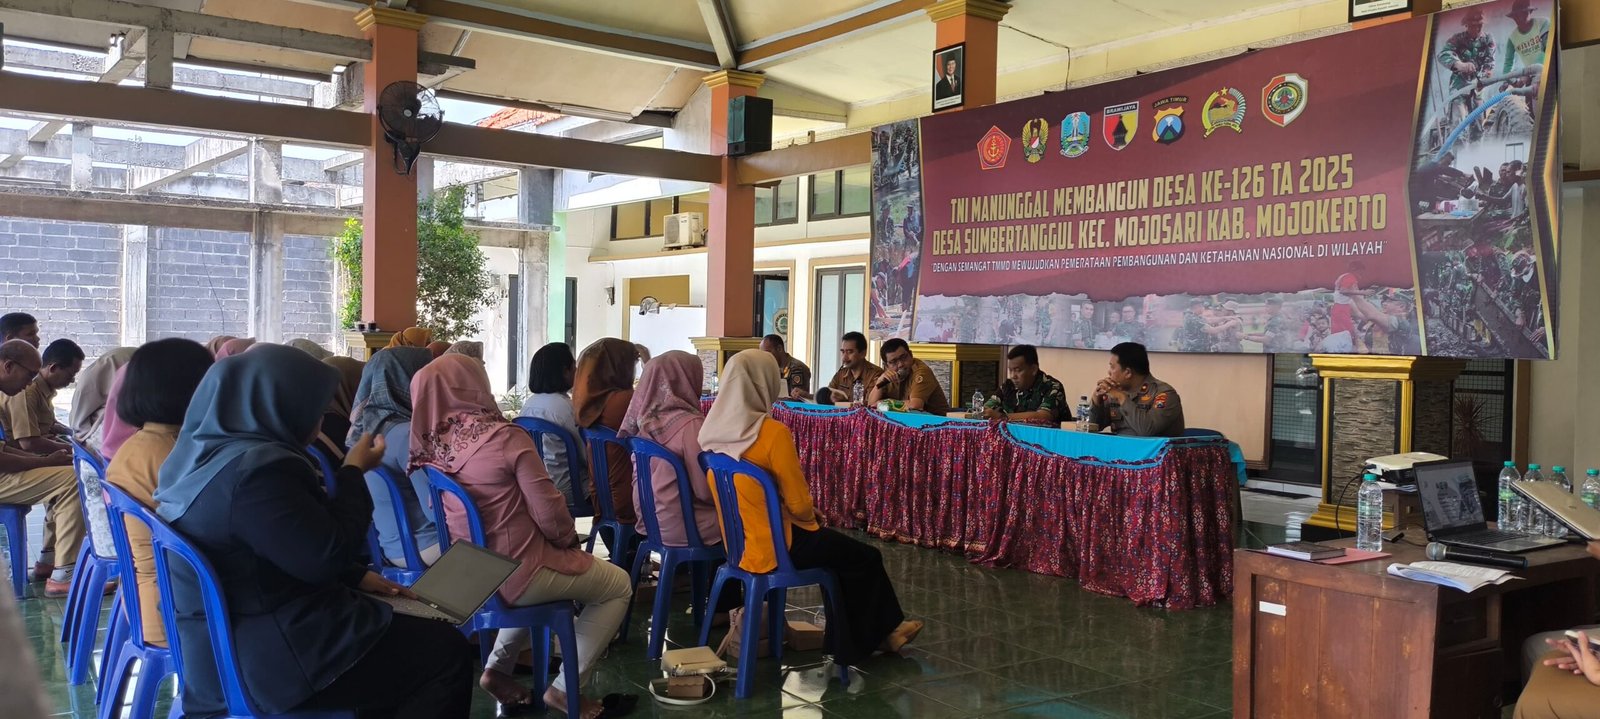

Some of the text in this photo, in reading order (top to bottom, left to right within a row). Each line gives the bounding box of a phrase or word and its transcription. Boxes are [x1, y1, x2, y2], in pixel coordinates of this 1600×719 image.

[1106, 104, 1136, 114] BRAWIJAYA
[1154, 98, 1169, 107] JAWA
[950, 153, 1353, 224] TNI MANUNGGAL MEMBANGUN DESA KE-126 TA 2025
[932, 193, 1387, 256] DESA SUMBERTANGGUL KEC. MOJOSARI KAB. MOJOKERTO
[958, 261, 990, 272] SEMANGAT
[992, 260, 1011, 271] TMMD
[1012, 258, 1060, 271] MEWUJUDKAN
[1061, 256, 1111, 269] PEMERATAAN
[1112, 253, 1177, 267] PEMBANGUNAN
[1179, 252, 1198, 265] DAN
[1200, 248, 1260, 263] KETAHANAN
[1262, 245, 1315, 260] NASIONAL
[1317, 244, 1328, 257] DI
